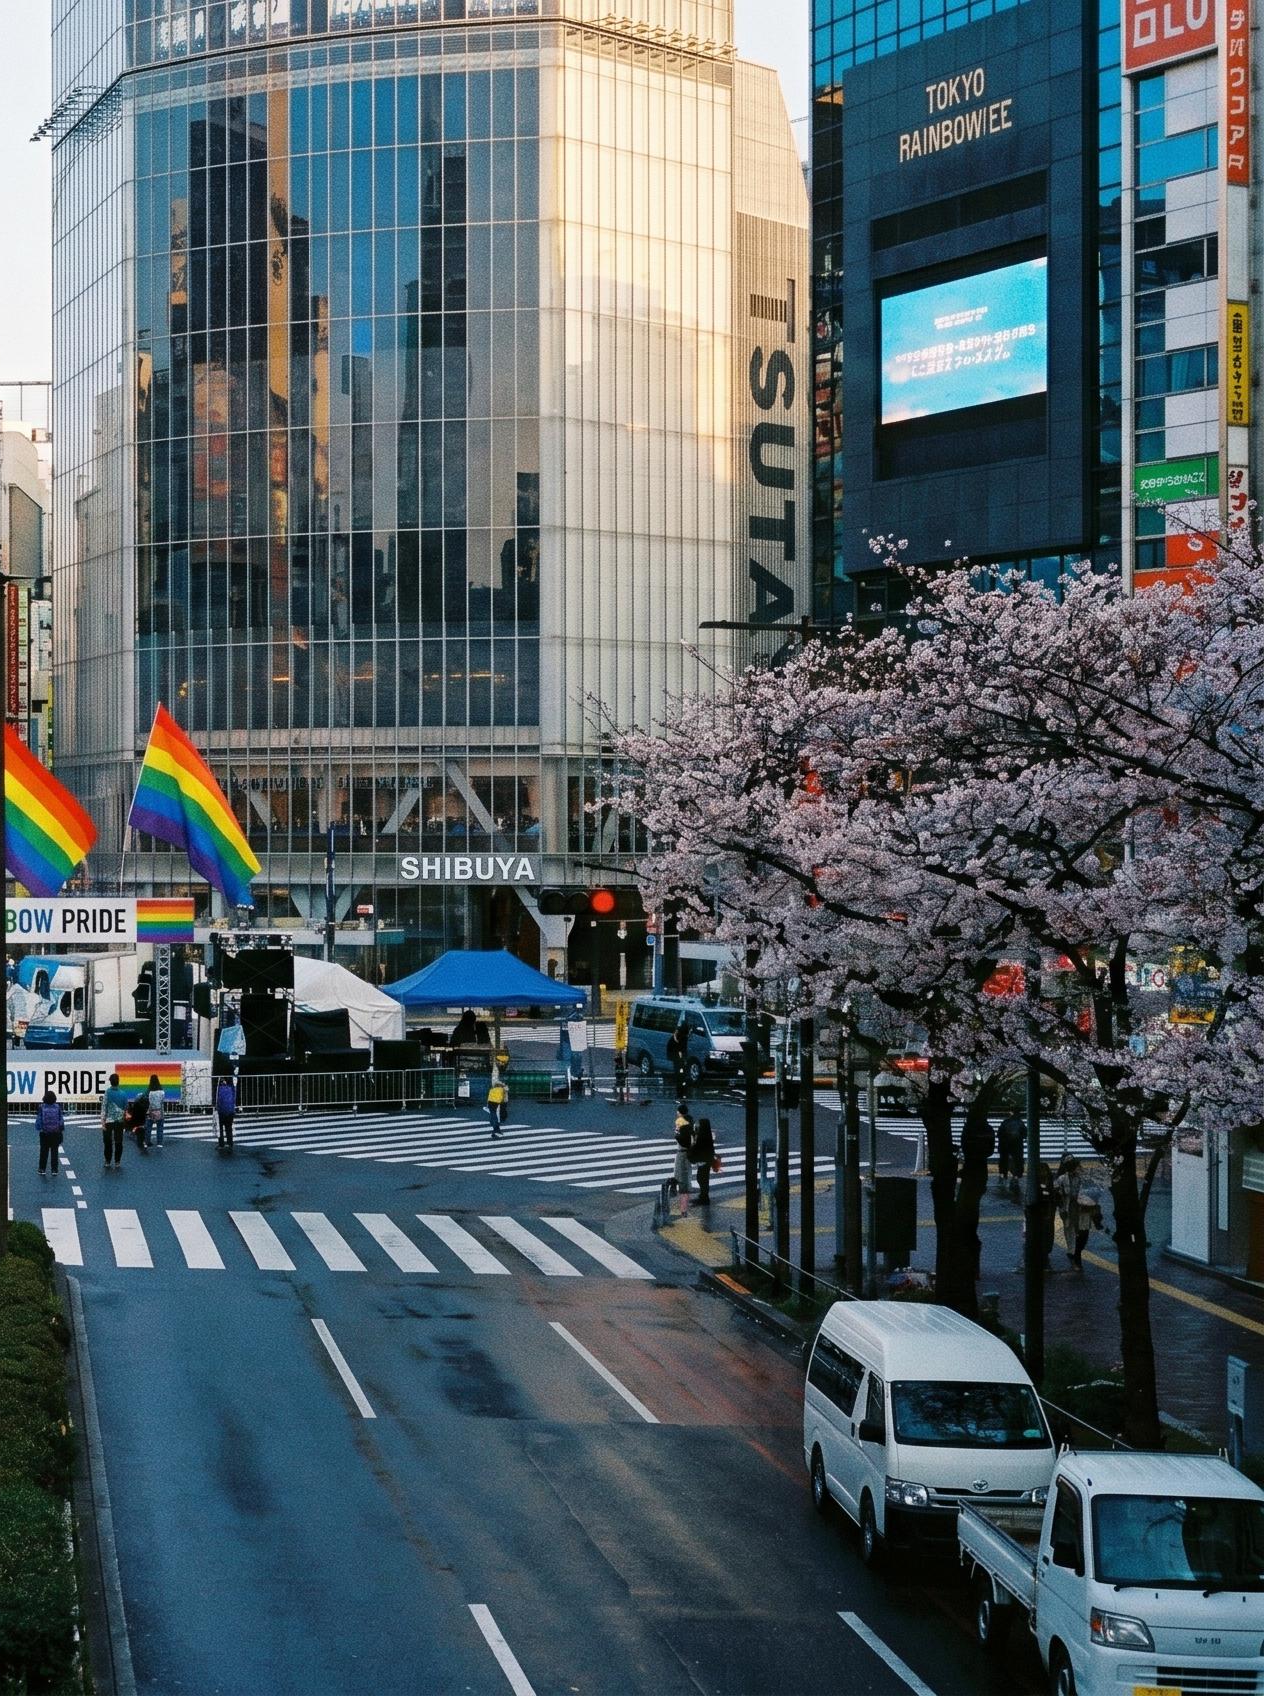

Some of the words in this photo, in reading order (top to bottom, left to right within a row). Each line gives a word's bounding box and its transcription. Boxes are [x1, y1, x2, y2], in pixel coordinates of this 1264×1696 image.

[926, 68, 984, 114] TOKYO
[749, 278, 795, 672] TSUTA
[401, 856, 535, 880] SHIBUYA
[61, 909, 127, 934] PRIDE
[44, 1070, 107, 1095] PRIDE
